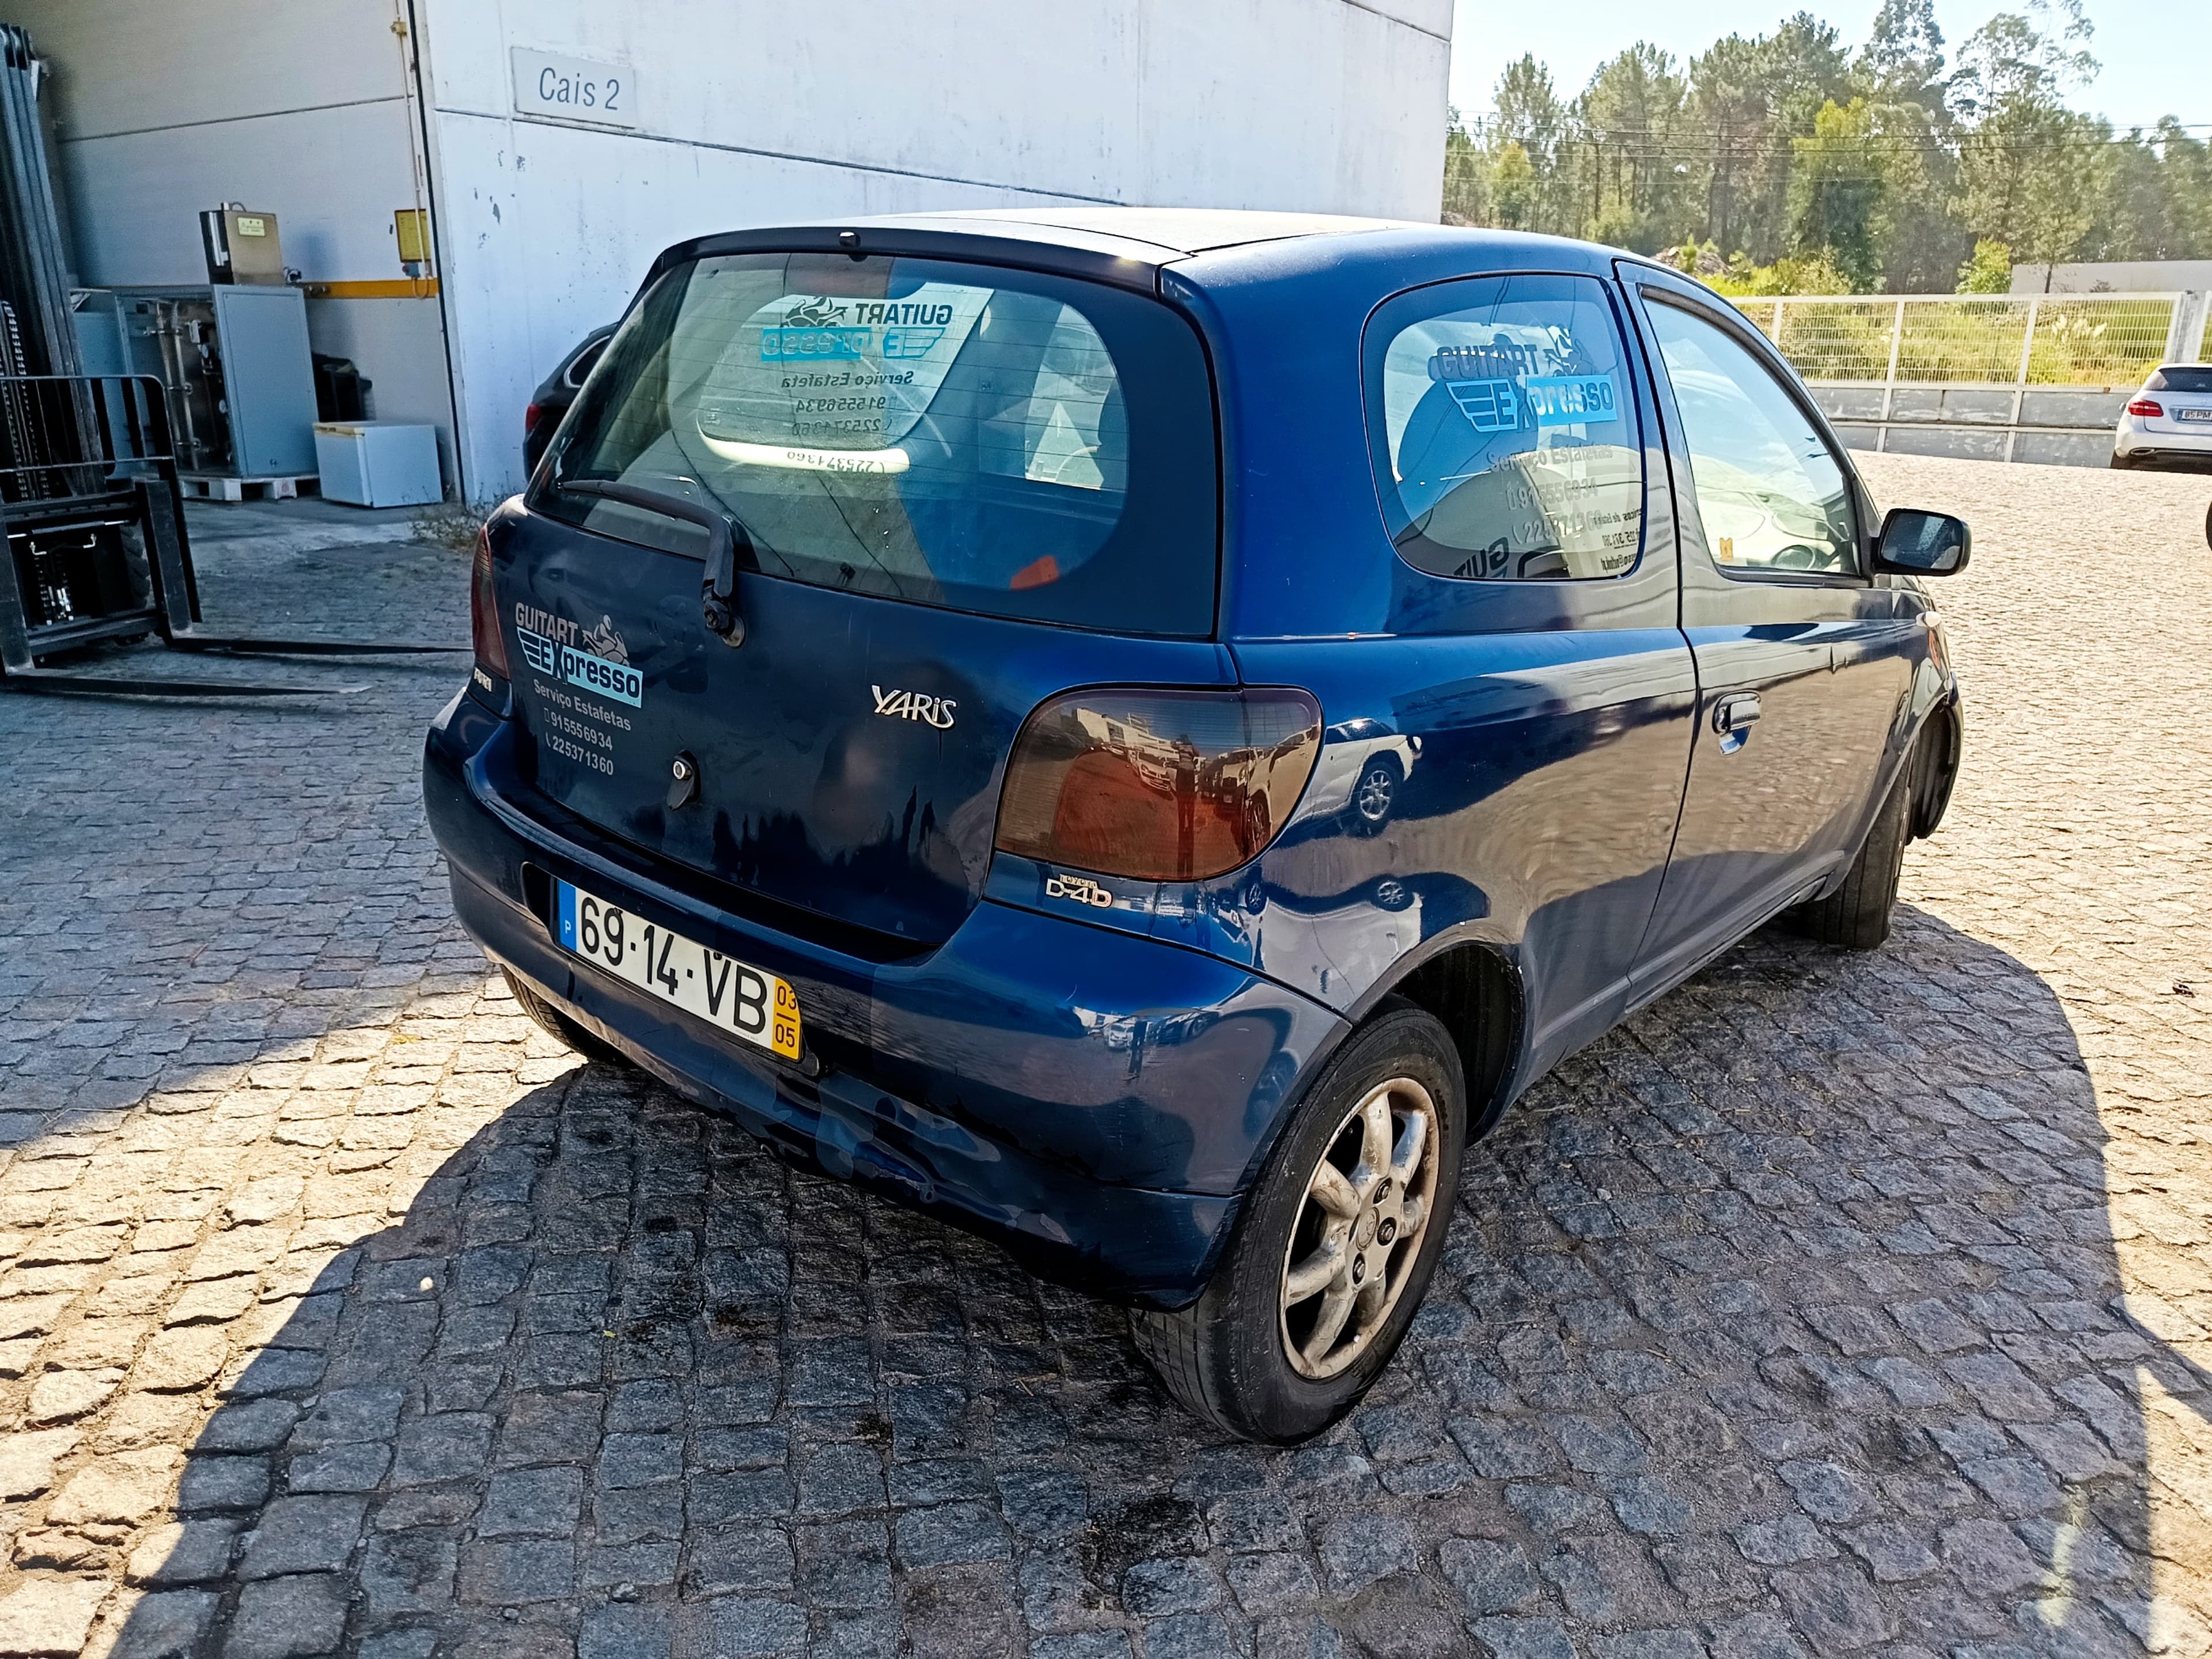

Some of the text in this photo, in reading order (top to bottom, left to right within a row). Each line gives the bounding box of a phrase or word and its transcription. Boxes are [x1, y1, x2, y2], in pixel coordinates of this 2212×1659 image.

[540, 67, 619, 110] Cais 2
[1437, 344, 1538, 379] GUITART
[1487, 452, 1547, 472] Serviço
[516, 602, 578, 646] GUITART
[533, 679, 631, 732] Serviço Estafetas
[551, 711, 613, 751] 915556934
[552, 736, 613, 775] 225371360
[1046, 878, 1112, 908] D-4D
[1059, 873, 1097, 889] TOYOTA
[565, 920, 571, 934] P
[777, 985, 797, 1010] 03
[775, 1024, 796, 1048] 05
